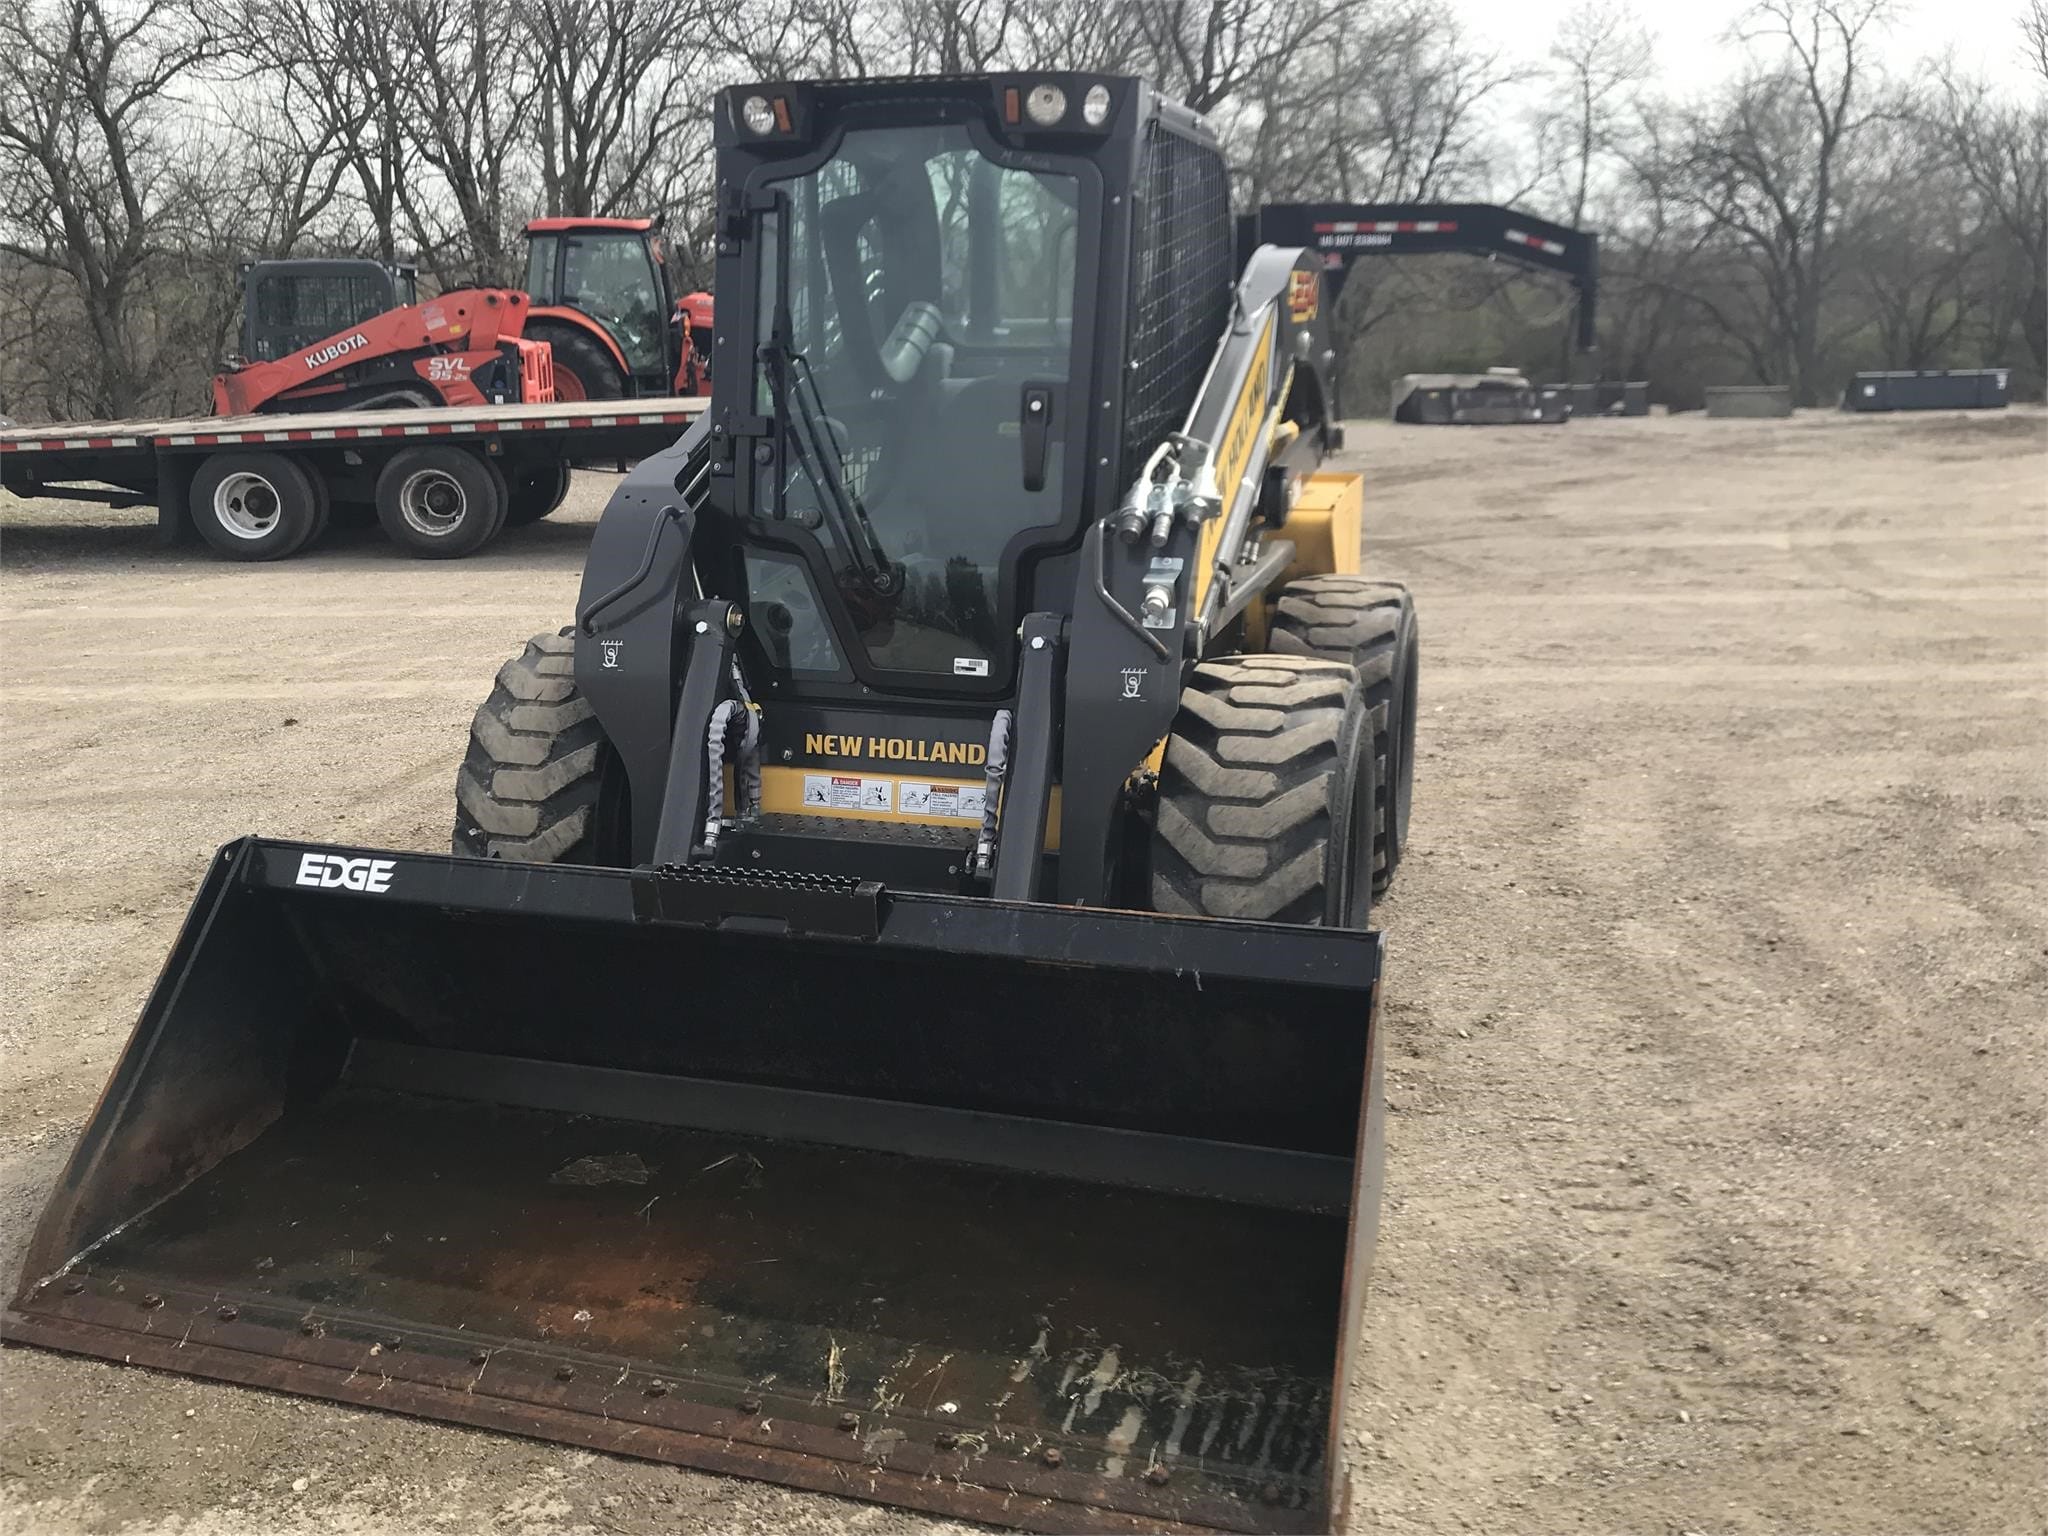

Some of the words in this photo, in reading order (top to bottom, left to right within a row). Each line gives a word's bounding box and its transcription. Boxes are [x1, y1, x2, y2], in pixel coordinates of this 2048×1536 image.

[304, 333, 369, 369] KUBOTA
[428, 358, 472, 371] SVL
[805, 733, 863, 757] NEW
[868, 737, 987, 765] HOLLAND
[295, 853, 397, 893] EDGE
